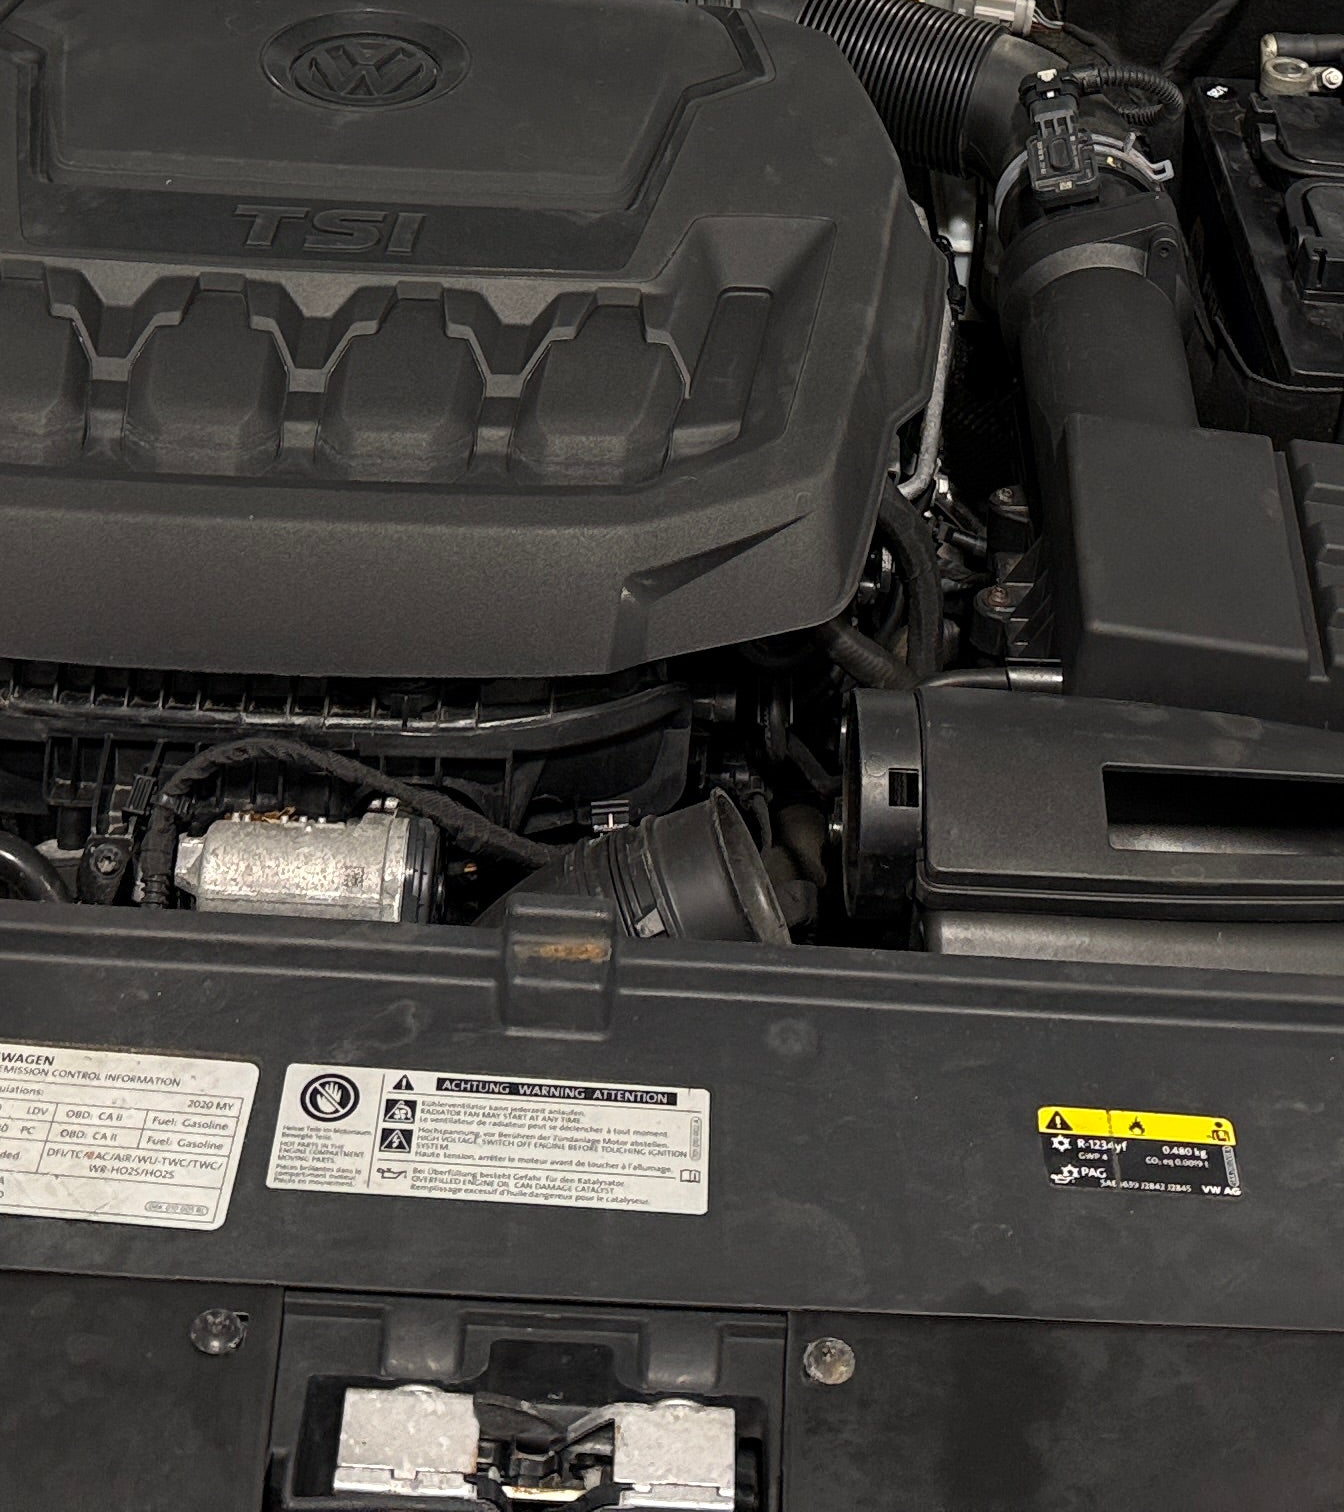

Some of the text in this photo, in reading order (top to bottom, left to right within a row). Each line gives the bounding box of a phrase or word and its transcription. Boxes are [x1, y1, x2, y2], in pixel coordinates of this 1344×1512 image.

[234, 204, 427, 255] TSI
[50, 1068, 102, 1080] CONTROL
[104, 1072, 181, 1086] INFORMATION
[441, 1079, 667, 1103] ACHTUNG WARNING ATTENTION
[187, 1099, 234, 1110] 2020 MY
[26, 1106, 48, 1115] LDV
[97, 1111, 114, 1121] CA
[181, 1117, 229, 1130] Gasoline
[19, 1125, 36, 1134] PC
[91, 1131, 108, 1141] CA
[176, 1137, 224, 1150] Gasoline
[1076, 1138, 1128, 1152] R-1234yf
[1192, 1148, 1208, 1159] kg
[1080, 1167, 1106, 1178] PAG
[1201, 1185, 1241, 1195] VW AG
